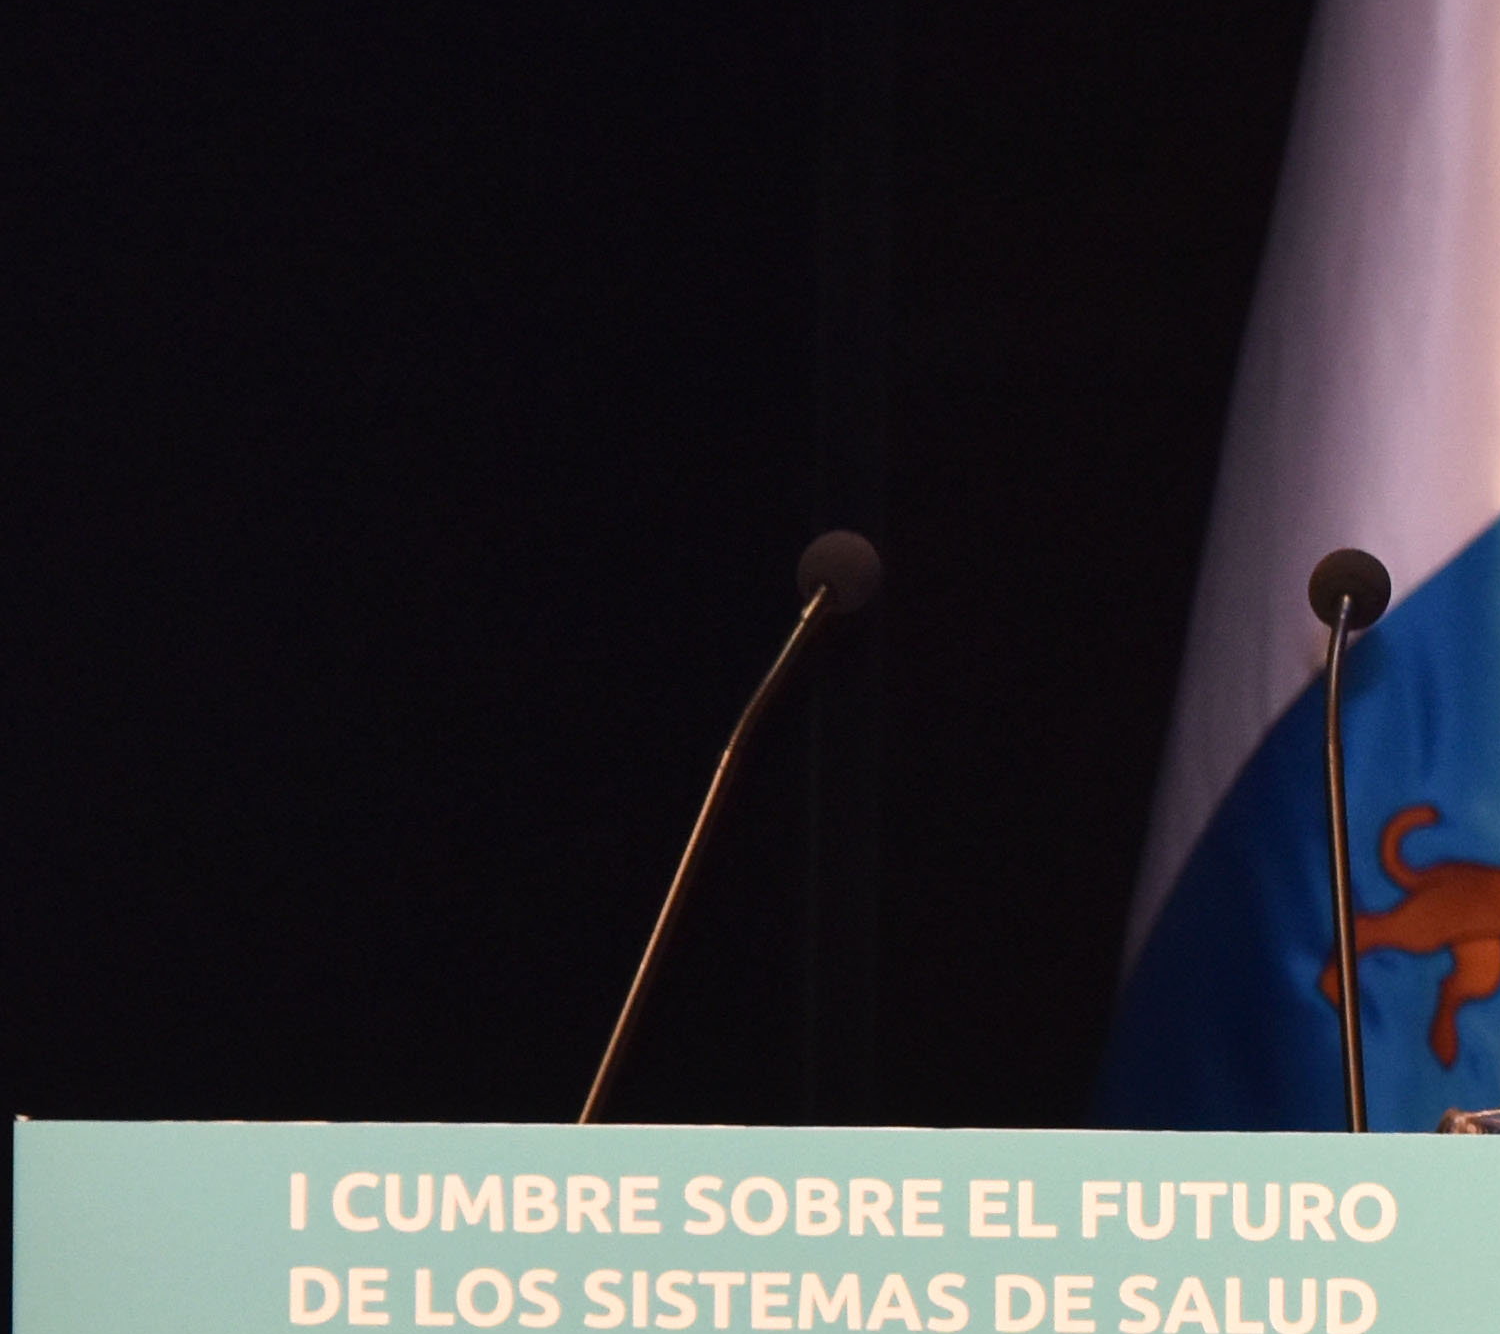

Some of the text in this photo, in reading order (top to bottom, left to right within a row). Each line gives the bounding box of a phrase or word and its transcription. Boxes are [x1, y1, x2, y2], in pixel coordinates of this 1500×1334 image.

[290, 1171, 1399, 1244] I CUMBRE SOBRE EL FUTURO
[289, 1266, 390, 1326] DE
[415, 1267, 561, 1329] LOS
[583, 1268, 970, 1334] SISTEMAS
[994, 1273, 1097, 1334] DE
